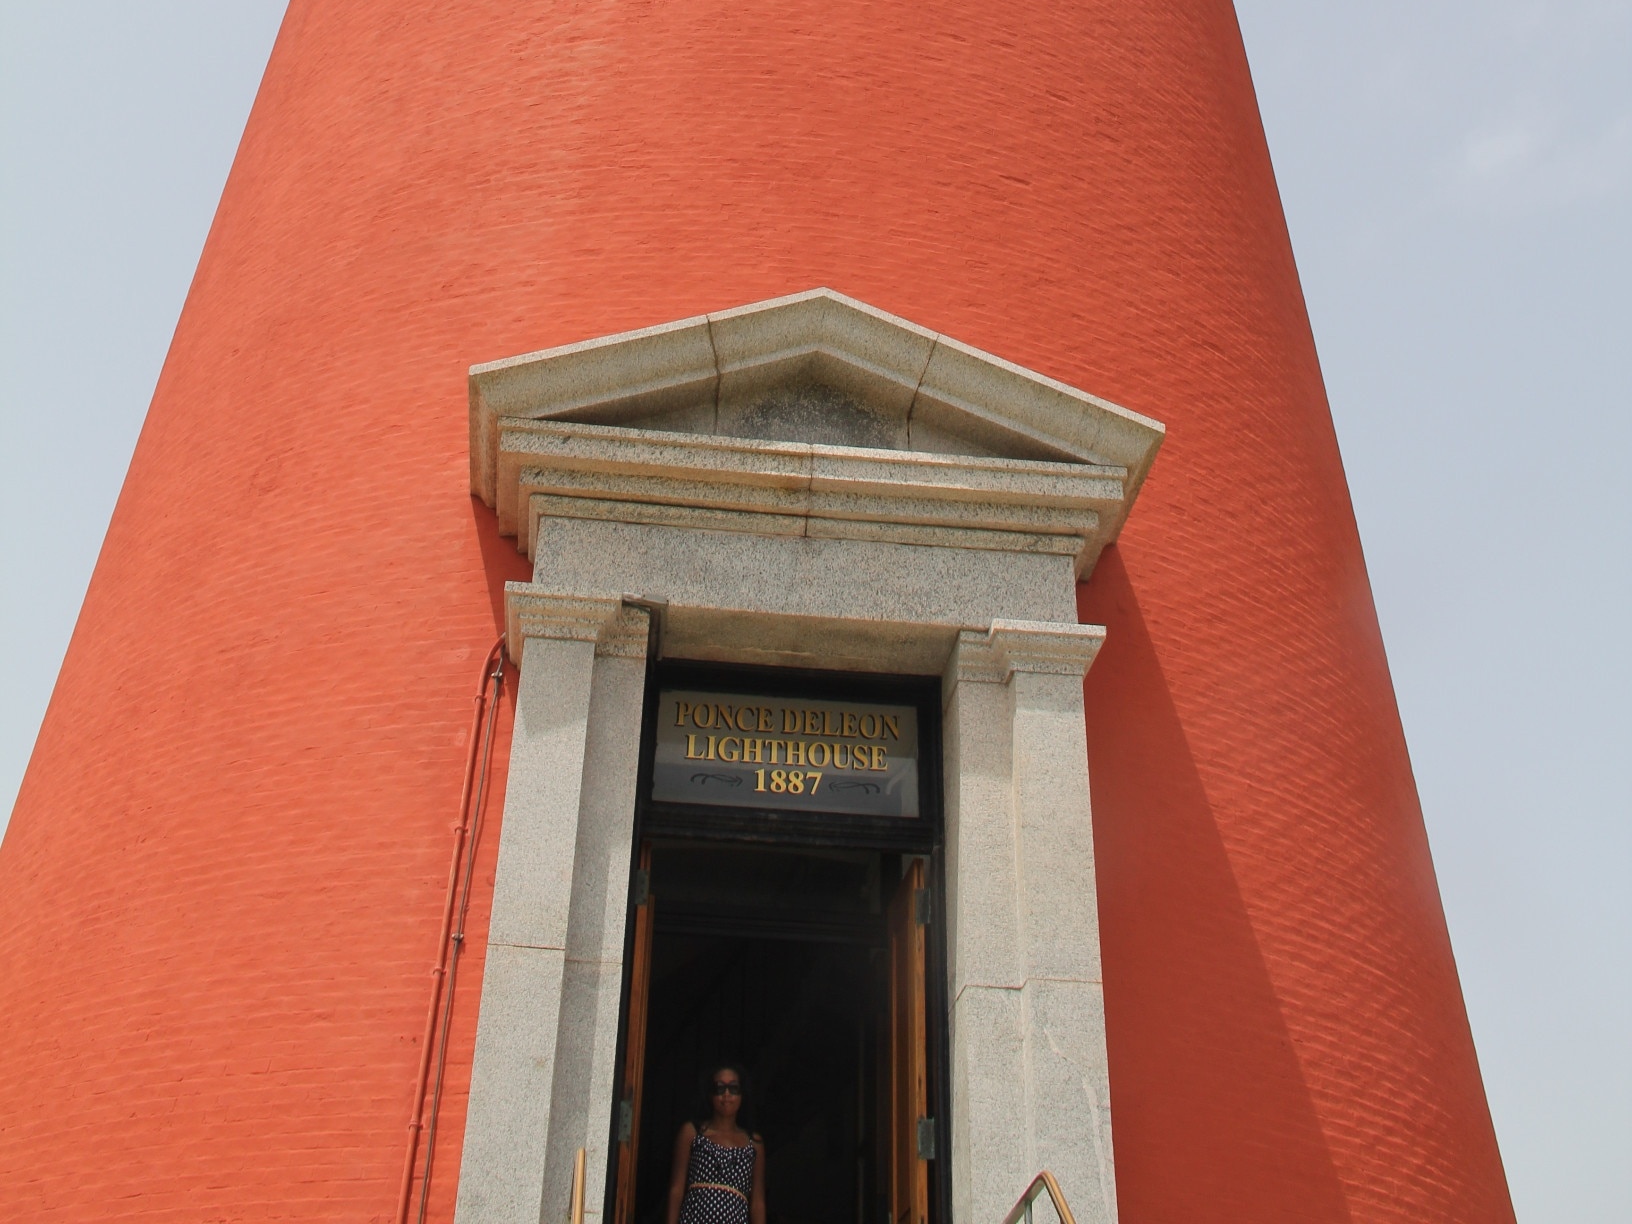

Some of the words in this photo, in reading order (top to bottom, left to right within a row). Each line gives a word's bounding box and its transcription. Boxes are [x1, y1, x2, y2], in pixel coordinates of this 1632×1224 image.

[675, 701, 774, 732] PONCE
[781, 708, 899, 740] DELEON
[685, 734, 888, 771] LIGHTHOUSE
[754, 768, 822, 795] 1887
